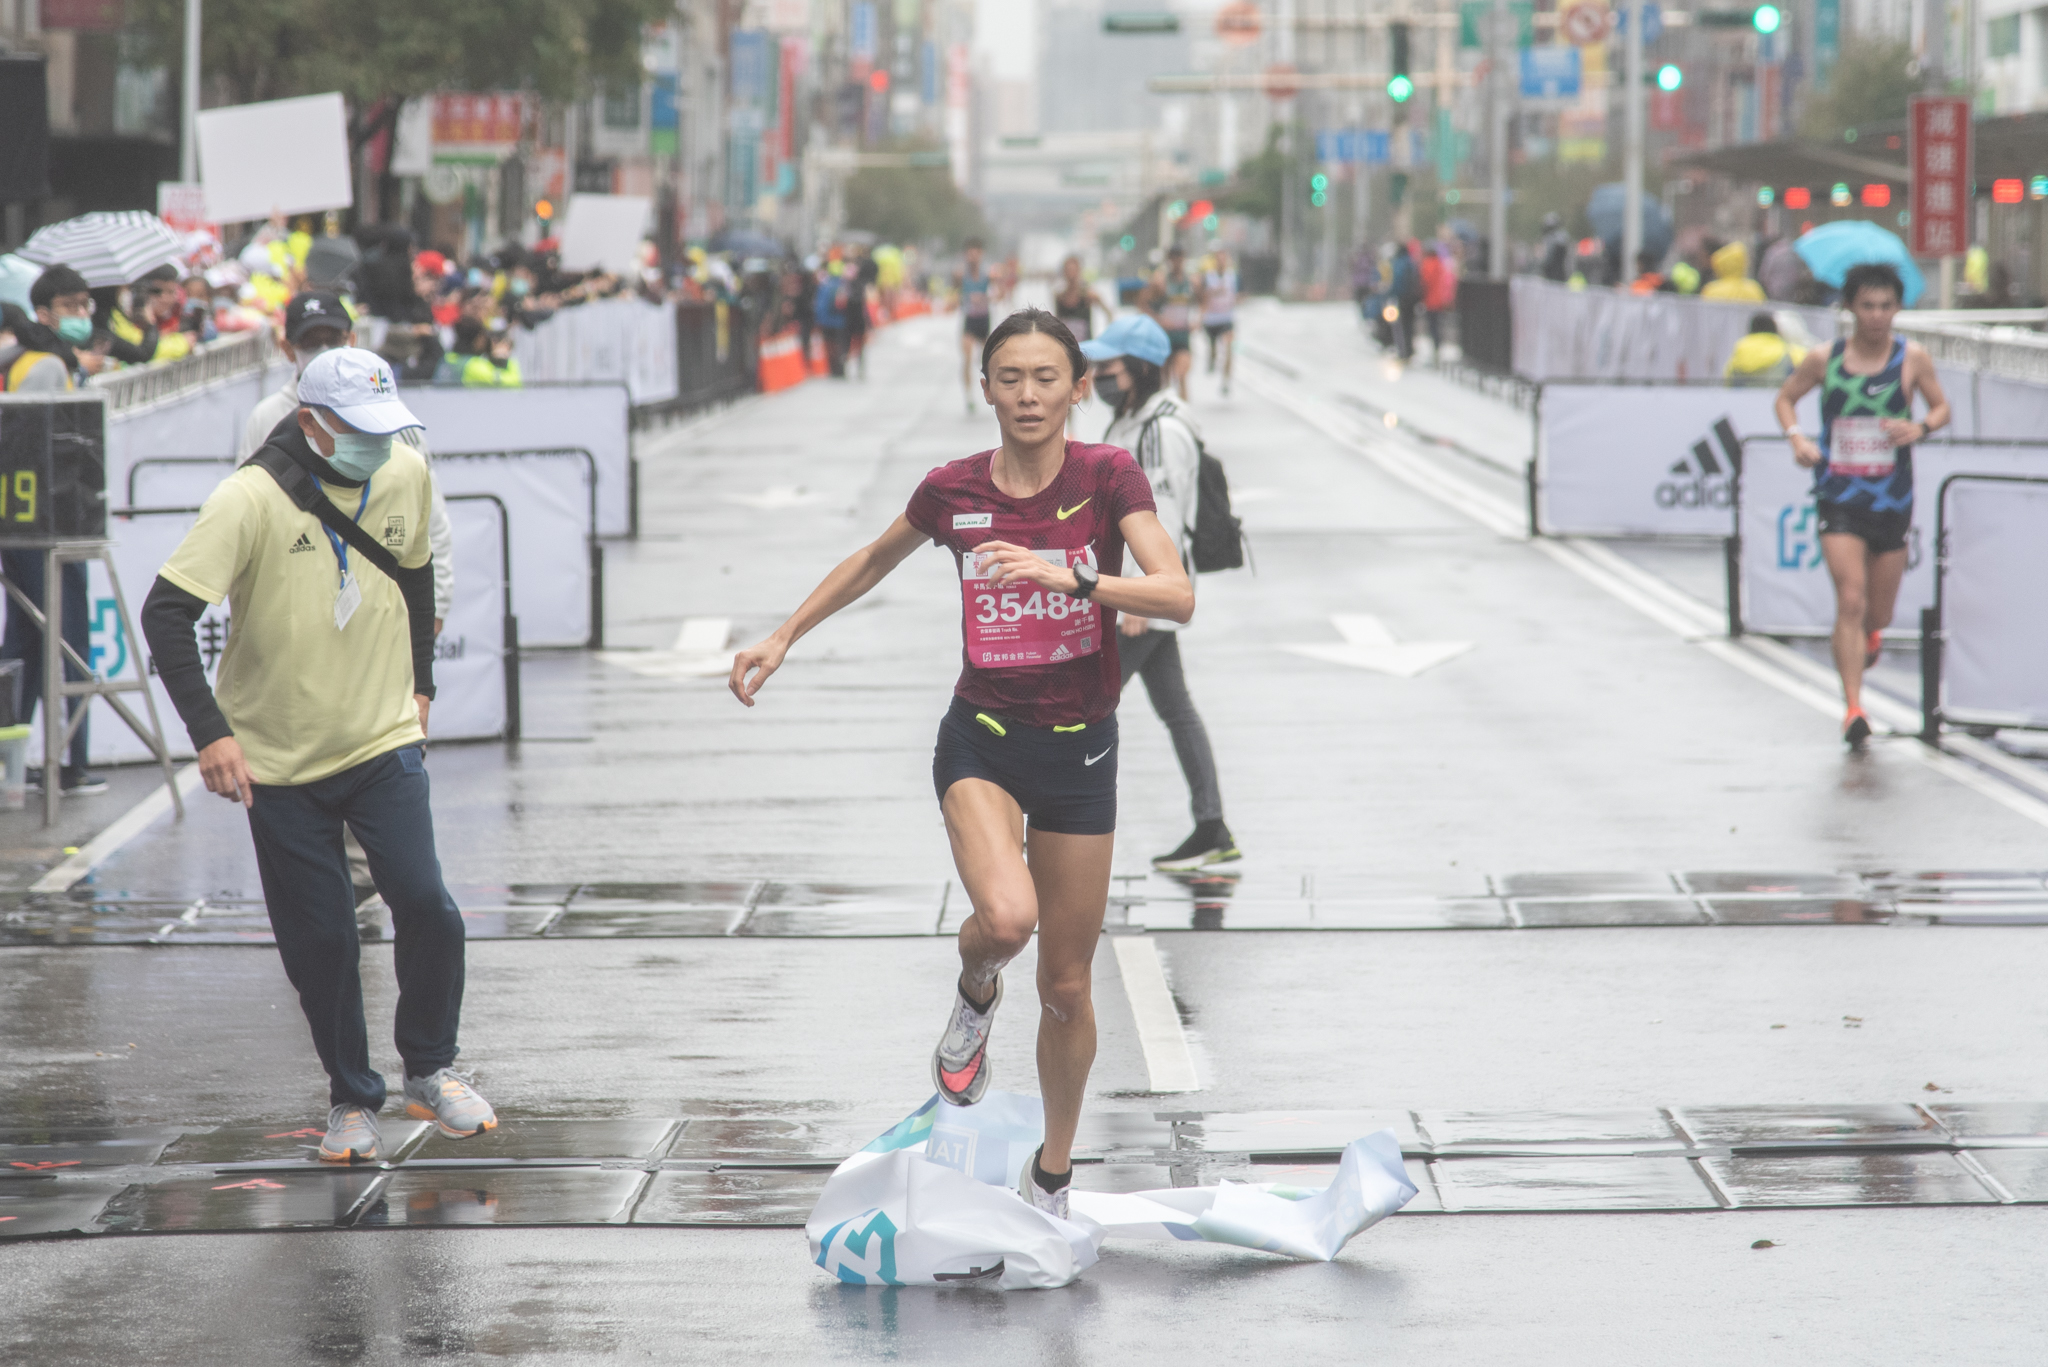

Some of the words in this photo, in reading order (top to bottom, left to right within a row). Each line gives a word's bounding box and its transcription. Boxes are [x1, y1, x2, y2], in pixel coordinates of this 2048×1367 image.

[289, 545, 316, 554] adidas
[975, 591, 1093, 623] 35484
[1049, 652, 1073, 661] adidas
